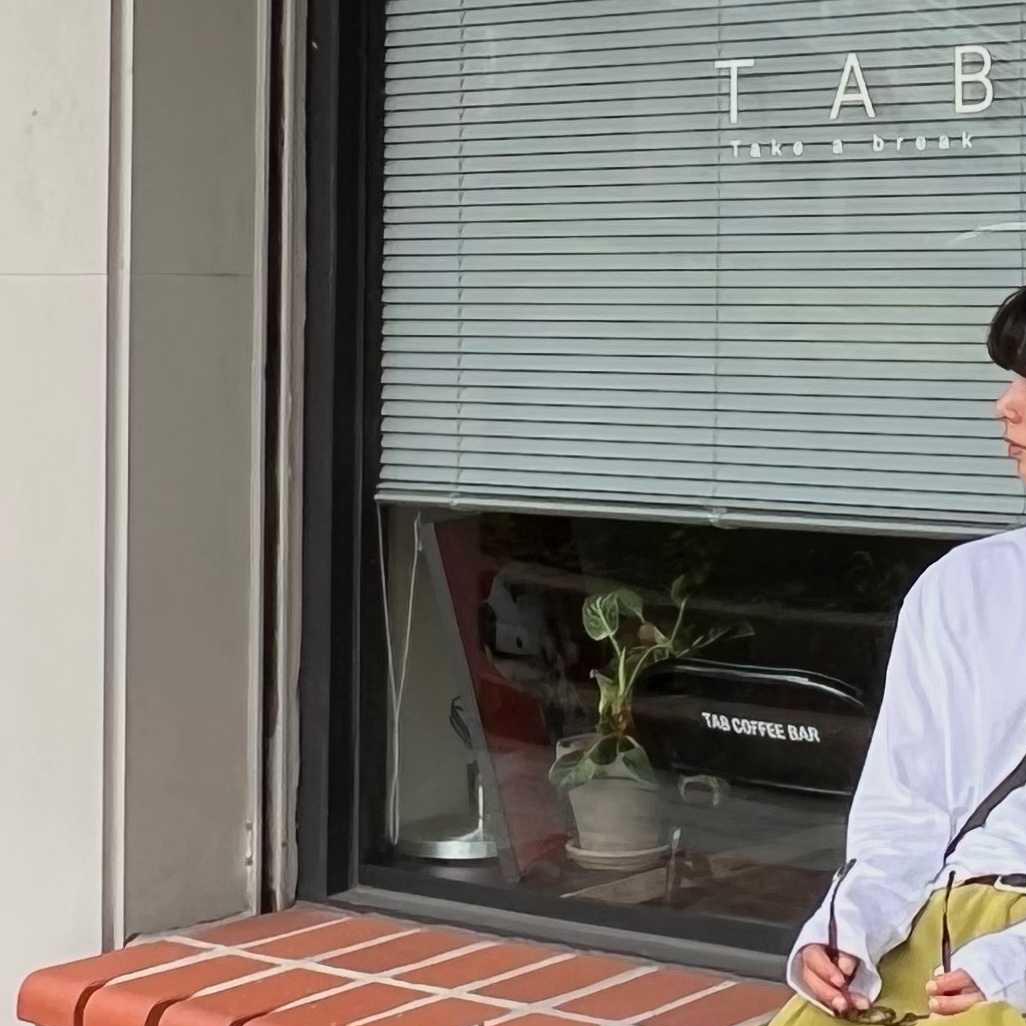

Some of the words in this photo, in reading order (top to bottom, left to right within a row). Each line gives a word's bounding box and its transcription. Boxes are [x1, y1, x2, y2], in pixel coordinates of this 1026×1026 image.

[713, 44, 995, 125] TAB
[701, 711, 732, 732] TAB
[731, 717, 787, 740] COFFEE
[787, 723, 821, 743] BAR
